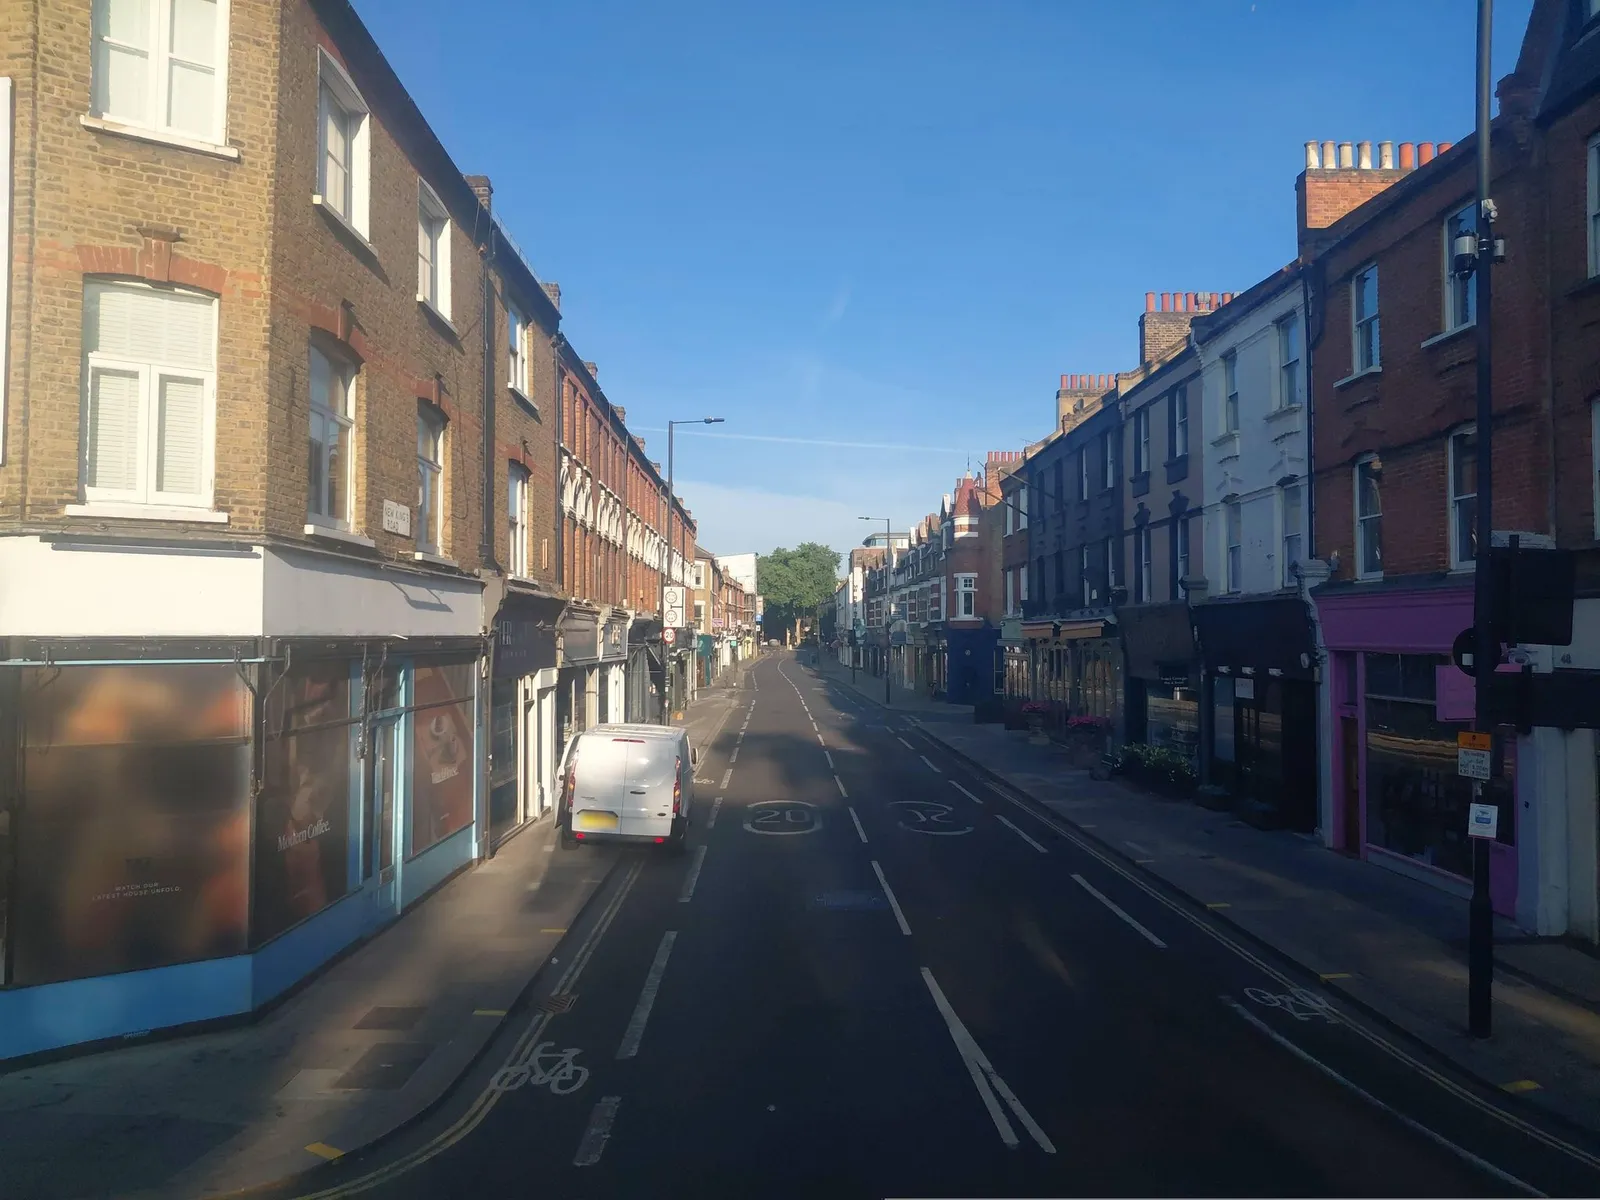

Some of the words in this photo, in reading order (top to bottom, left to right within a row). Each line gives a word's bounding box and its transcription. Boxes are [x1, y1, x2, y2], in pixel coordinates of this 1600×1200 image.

[387, 519, 398, 531] ROAD
[754, 809, 810, 823] 20
[278, 830, 306, 852] Modern
[92, 892, 120, 901] LATEST
